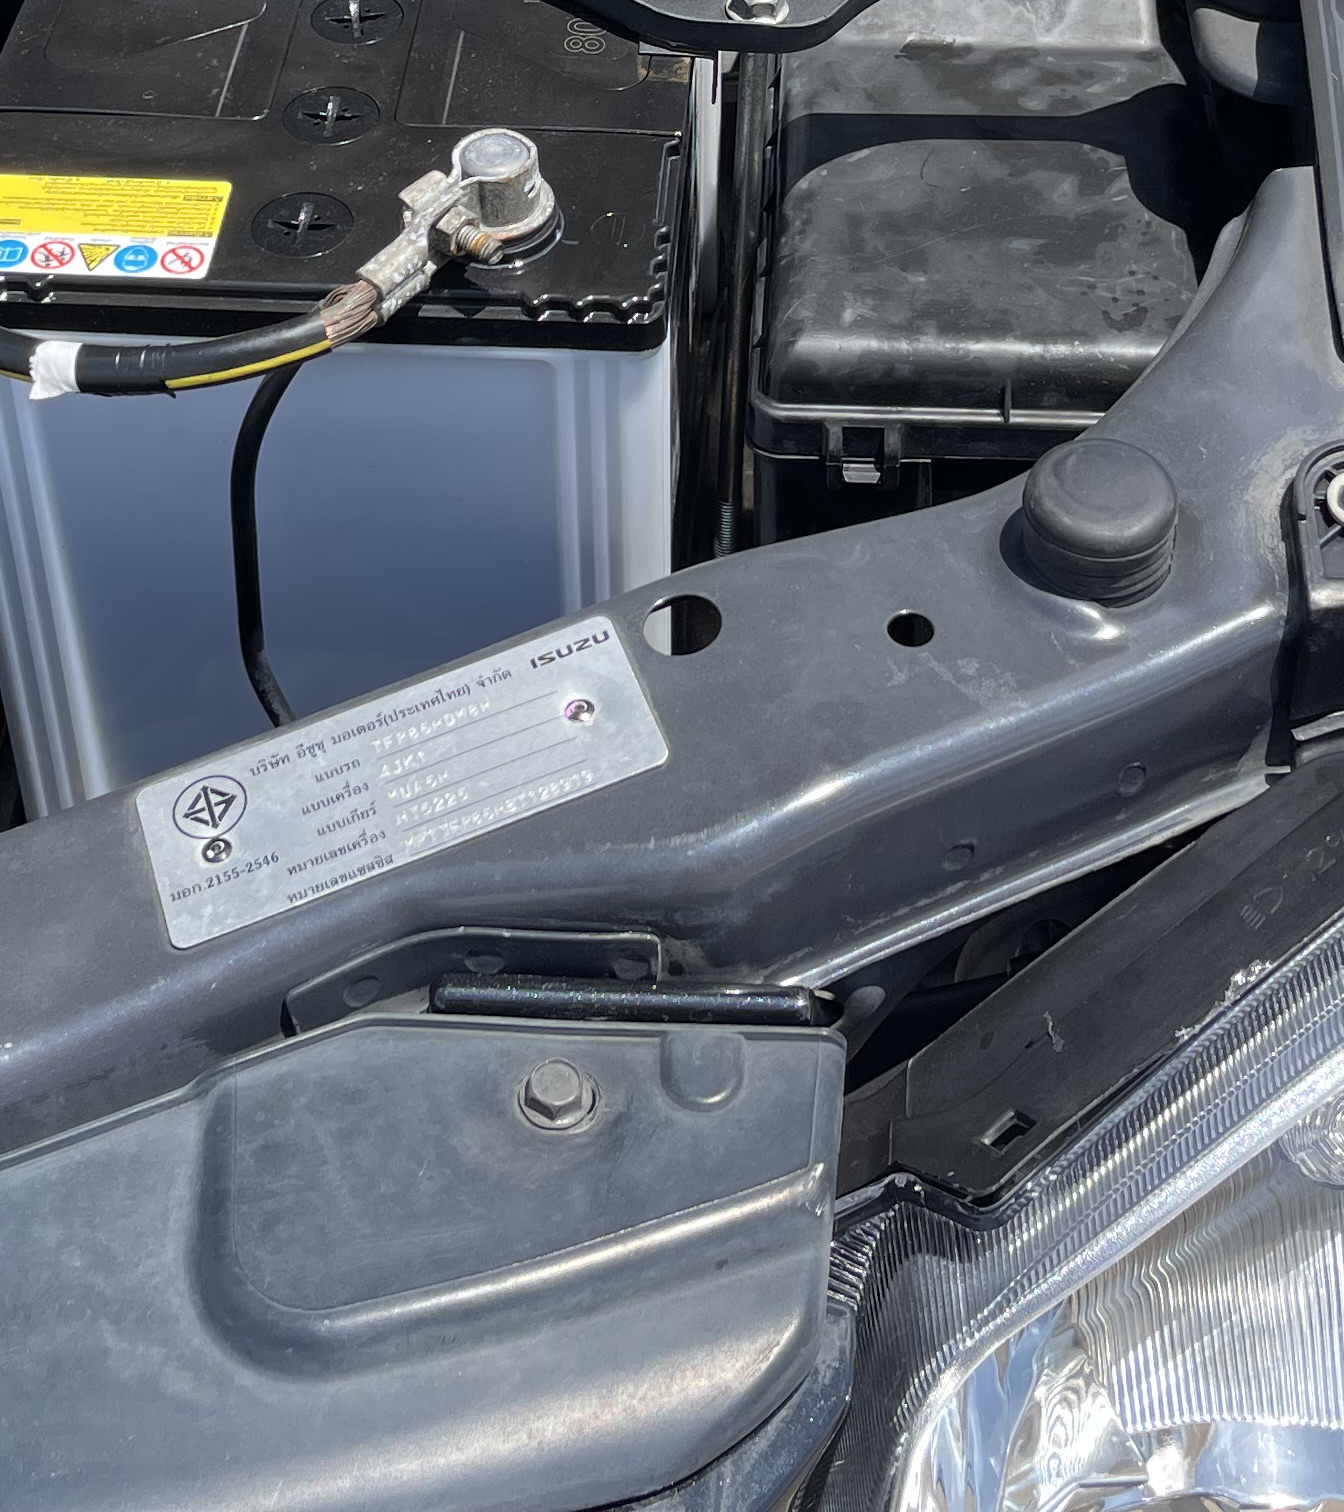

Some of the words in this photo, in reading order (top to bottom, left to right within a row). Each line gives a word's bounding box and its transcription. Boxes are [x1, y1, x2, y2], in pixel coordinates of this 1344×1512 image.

[529, 629, 611, 670] ISUZU
[249, 752, 291, 778] บริษัท
[475, 665, 513, 690] จำกัด
[314, 757, 361, 784] แบบรถ
[302, 779, 370, 816] แบบเครื่อง
[316, 800, 378, 837] แบบเกียร์
[286, 828, 387, 877] หมายเลขเครื่อง
[170, 850, 280, 903] มอก.2155-2546
